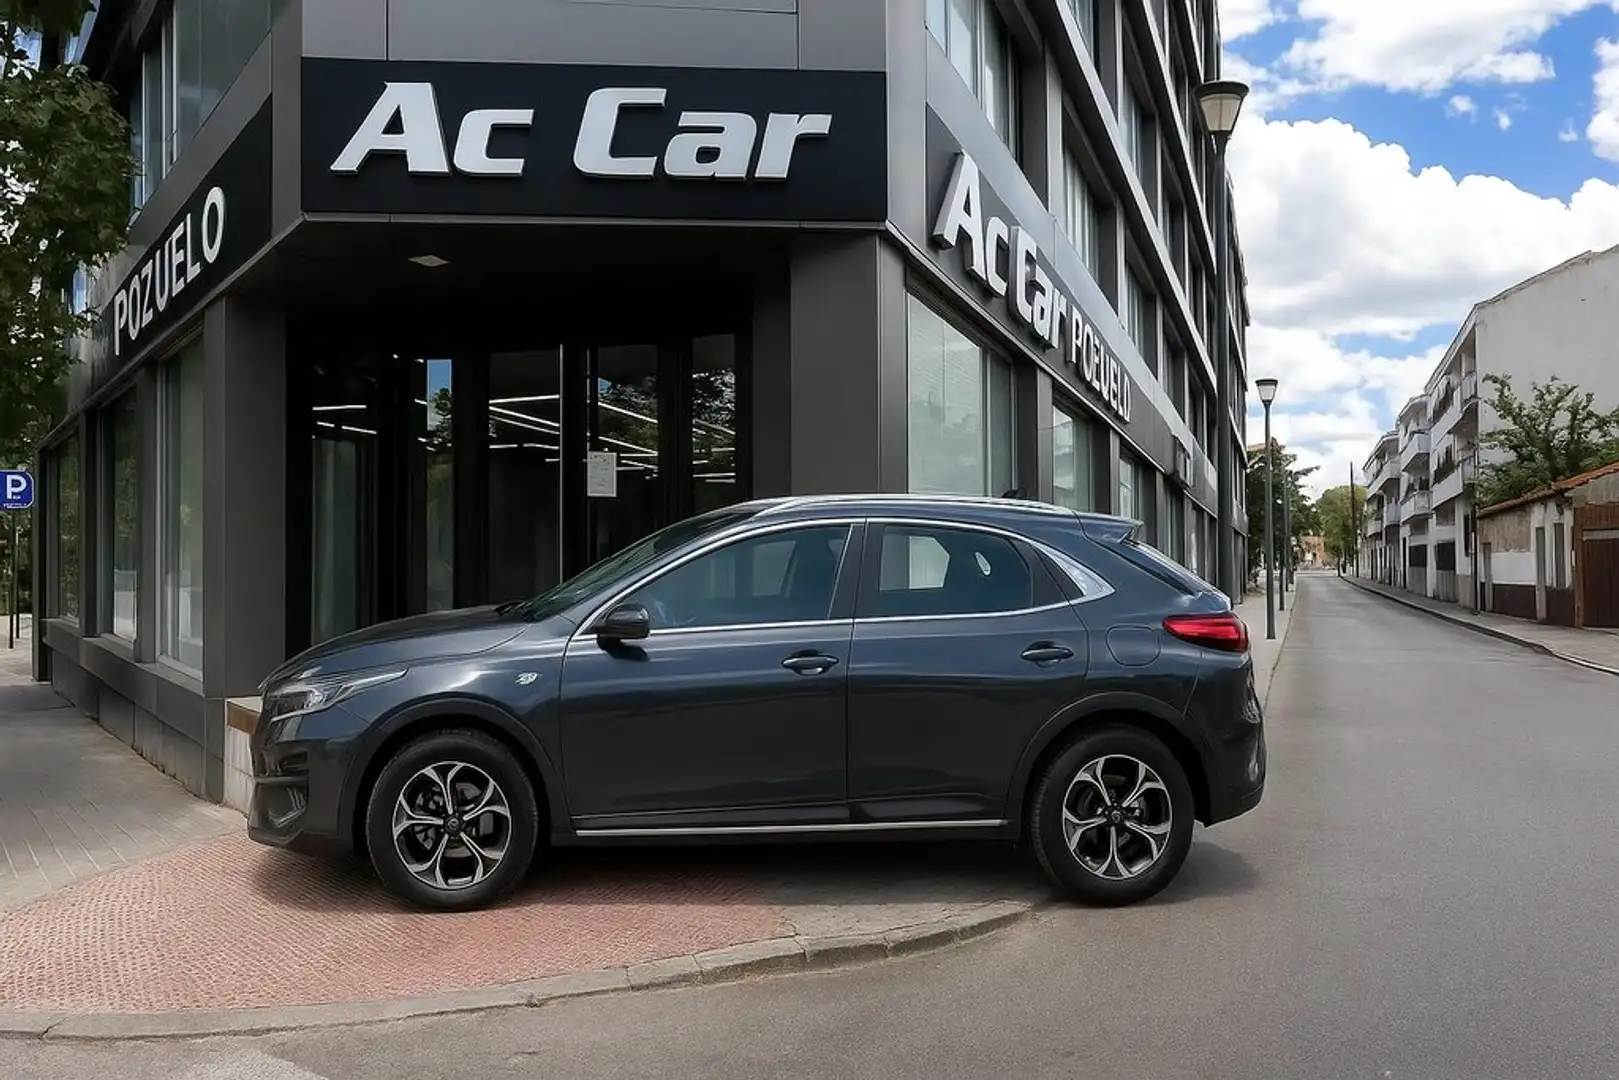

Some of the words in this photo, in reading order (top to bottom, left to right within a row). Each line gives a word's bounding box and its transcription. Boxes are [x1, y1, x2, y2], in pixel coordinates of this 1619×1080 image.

[330, 81, 534, 177] Ac
[573, 86, 832, 181] Car
[112, 186, 225, 356] POZUELO
[933, 151, 1009, 297] Ac
[1009, 225, 1067, 349] Car
[6, 474, 27, 500] P
